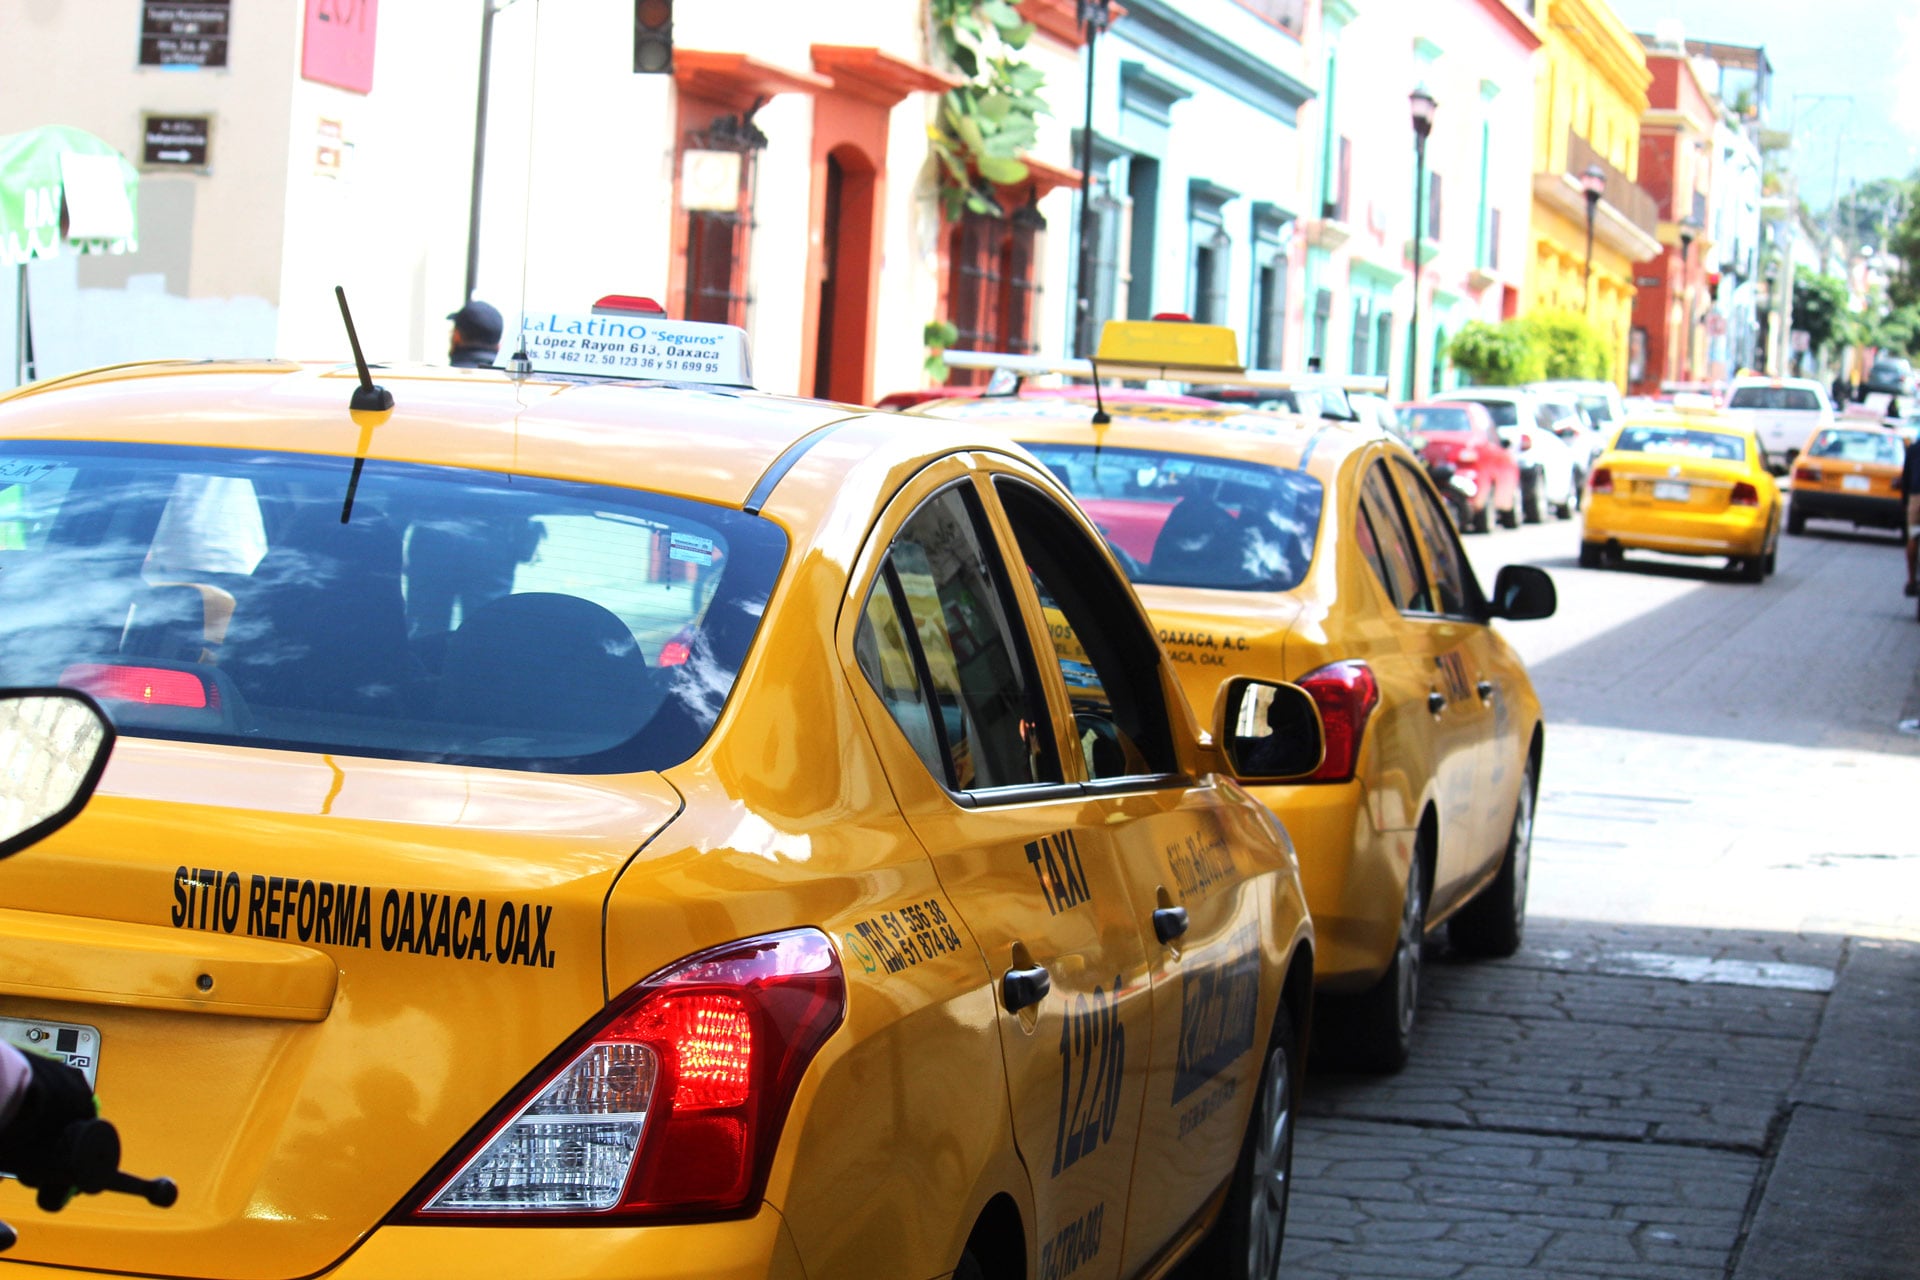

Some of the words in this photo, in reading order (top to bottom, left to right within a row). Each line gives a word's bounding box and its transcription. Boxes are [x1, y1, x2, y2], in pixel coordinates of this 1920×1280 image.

[549, 314, 647, 340] Latino
[544, 350, 556, 360] 51
[560, 352, 580, 363] 462
[602, 355, 616, 365] 50
[620, 357, 638, 367] 123
[641, 358, 654, 368] 36
[657, 361, 663, 370] y
[666, 360, 678, 370] 51
[682, 361, 702, 372] 699
[705, 363, 719, 374] 95
[581, 338, 625, 352] Rayon
[666, 345, 719, 360] Oaxaca
[1222, 635, 1250, 651] A.C.
[1024, 829, 1091, 916] TAXI
[171, 865, 240, 934] SITIO
[247, 874, 371, 949] REFORMA
[495, 901, 556, 969] OAX.
[881, 911, 907, 939] 51
[899, 904, 931, 933] 556
[924, 899, 948, 925] 38
[898, 936, 923, 966] 51
[916, 929, 947, 960] 874
[939, 924, 962, 952] 84
[1051, 974, 1124, 1180] 1226
